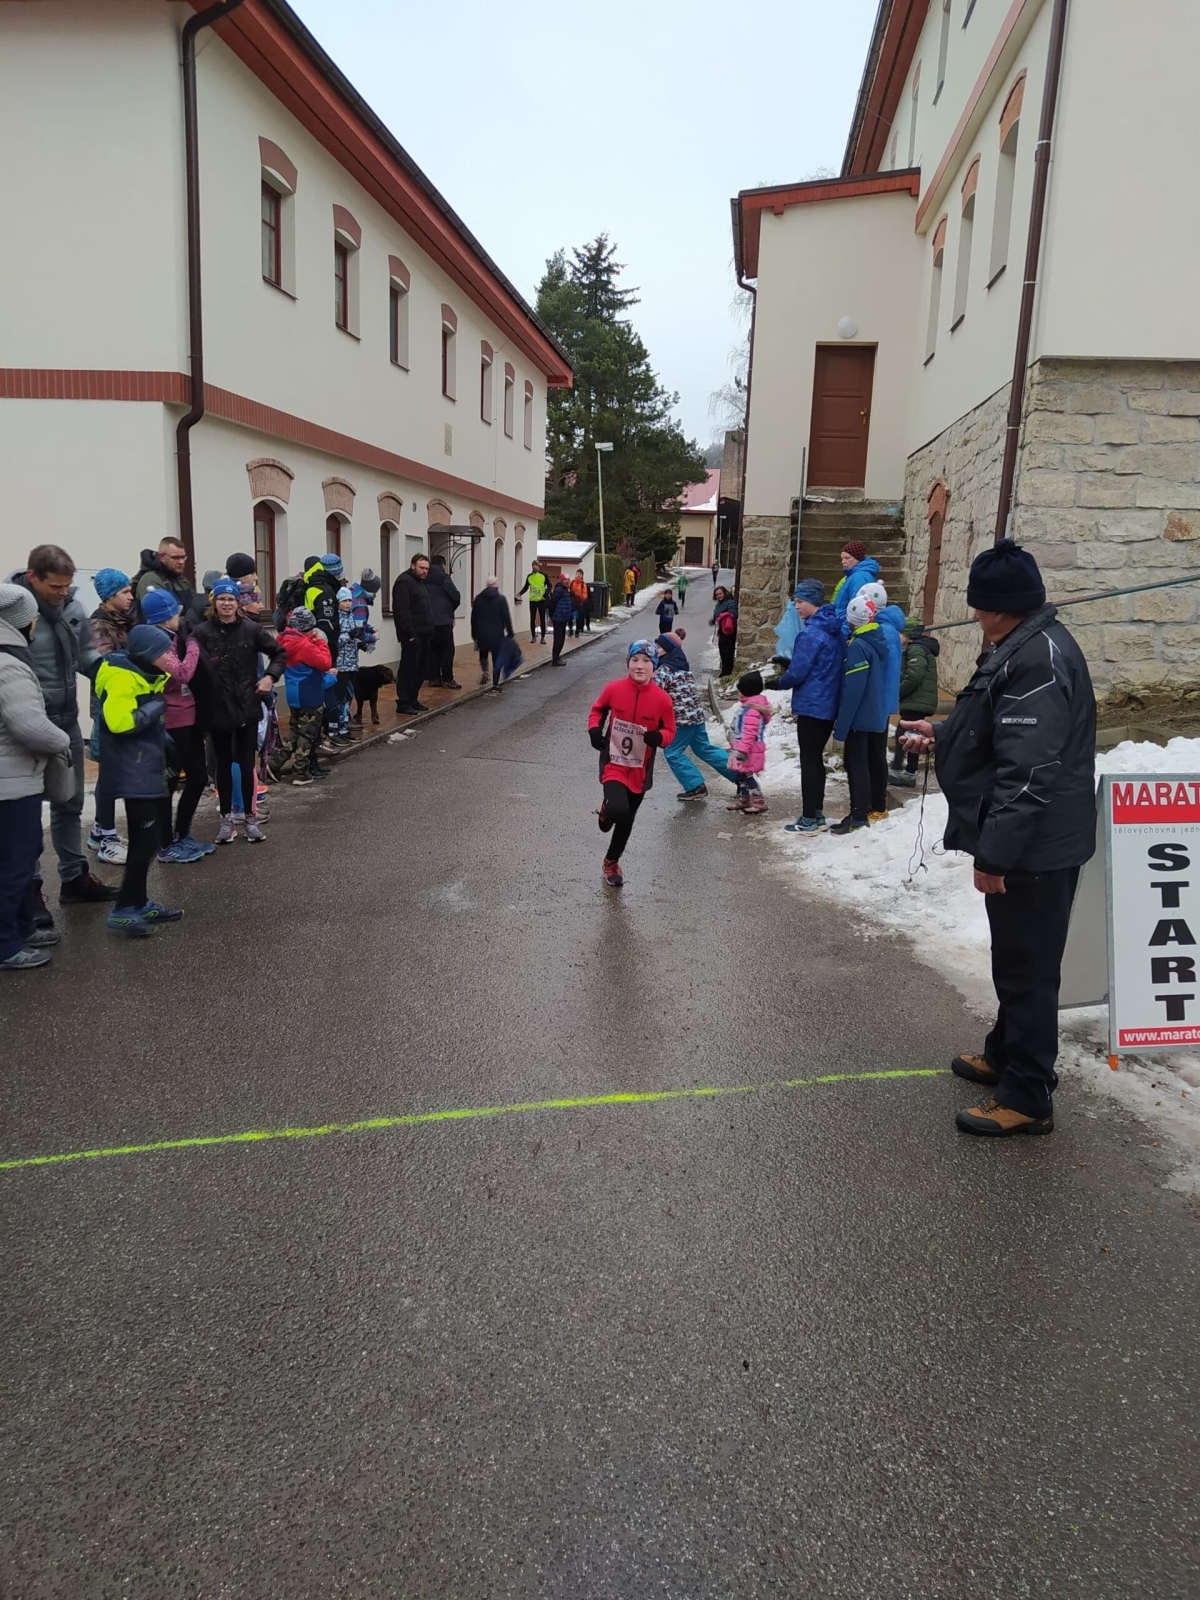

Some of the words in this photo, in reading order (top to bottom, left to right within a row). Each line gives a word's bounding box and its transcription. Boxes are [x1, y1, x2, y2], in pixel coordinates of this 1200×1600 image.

[622, 736, 633, 756] 9
[1114, 826, 1176, 835] tělovýchovná
[1147, 843, 1197, 1021] START
